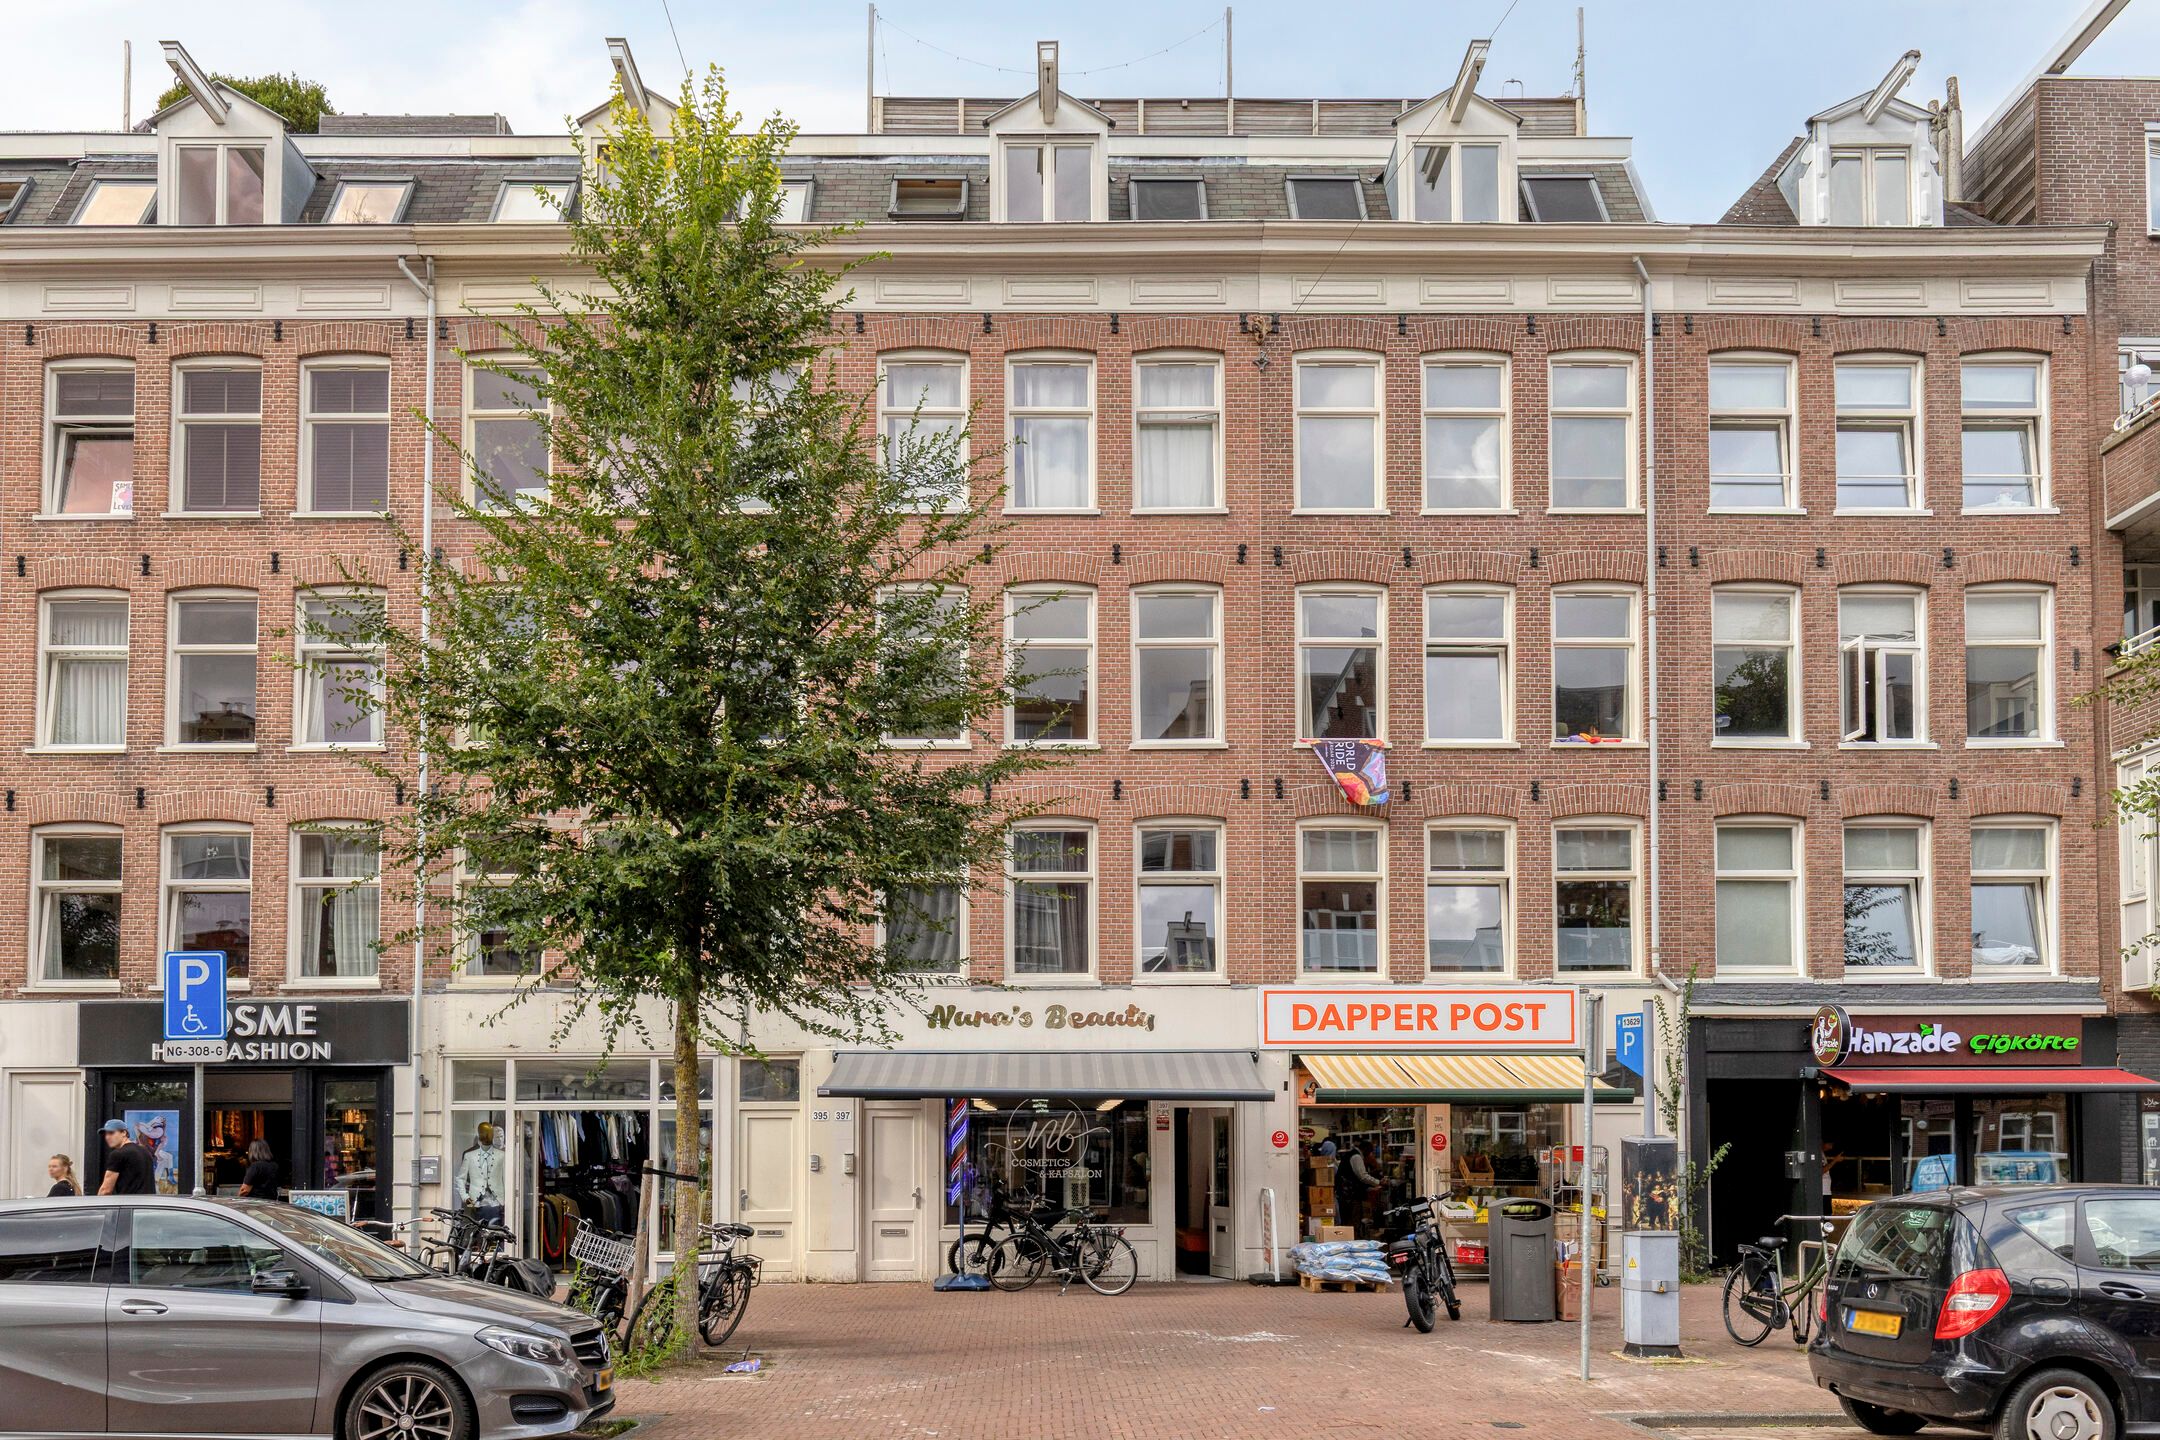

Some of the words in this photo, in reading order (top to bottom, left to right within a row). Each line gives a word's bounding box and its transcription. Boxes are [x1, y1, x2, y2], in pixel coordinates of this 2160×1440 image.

[1335, 741, 1345, 765] RIDE
[1345, 741, 1356, 770] ORLD
[179, 959, 210, 1001] P
[226, 1005, 318, 1036] SME
[1045, 1003, 1155, 1032] Beauty
[1292, 1003, 1439, 1032] DAPPER
[1450, 1002, 1546, 1032] POST
[227, 1041, 332, 1061] ASHION
[1624, 1031, 1635, 1056] P
[1849, 1024, 1961, 1054] Hanzade
[166, 1046, 223, 1057] NG-308-G
[813, 1111, 829, 1120] 395
[835, 1111, 851, 1120] 397
[1011, 1158, 1071, 1168] COSMETICS
[1048, 1169, 1102, 1179] KAPSALON
